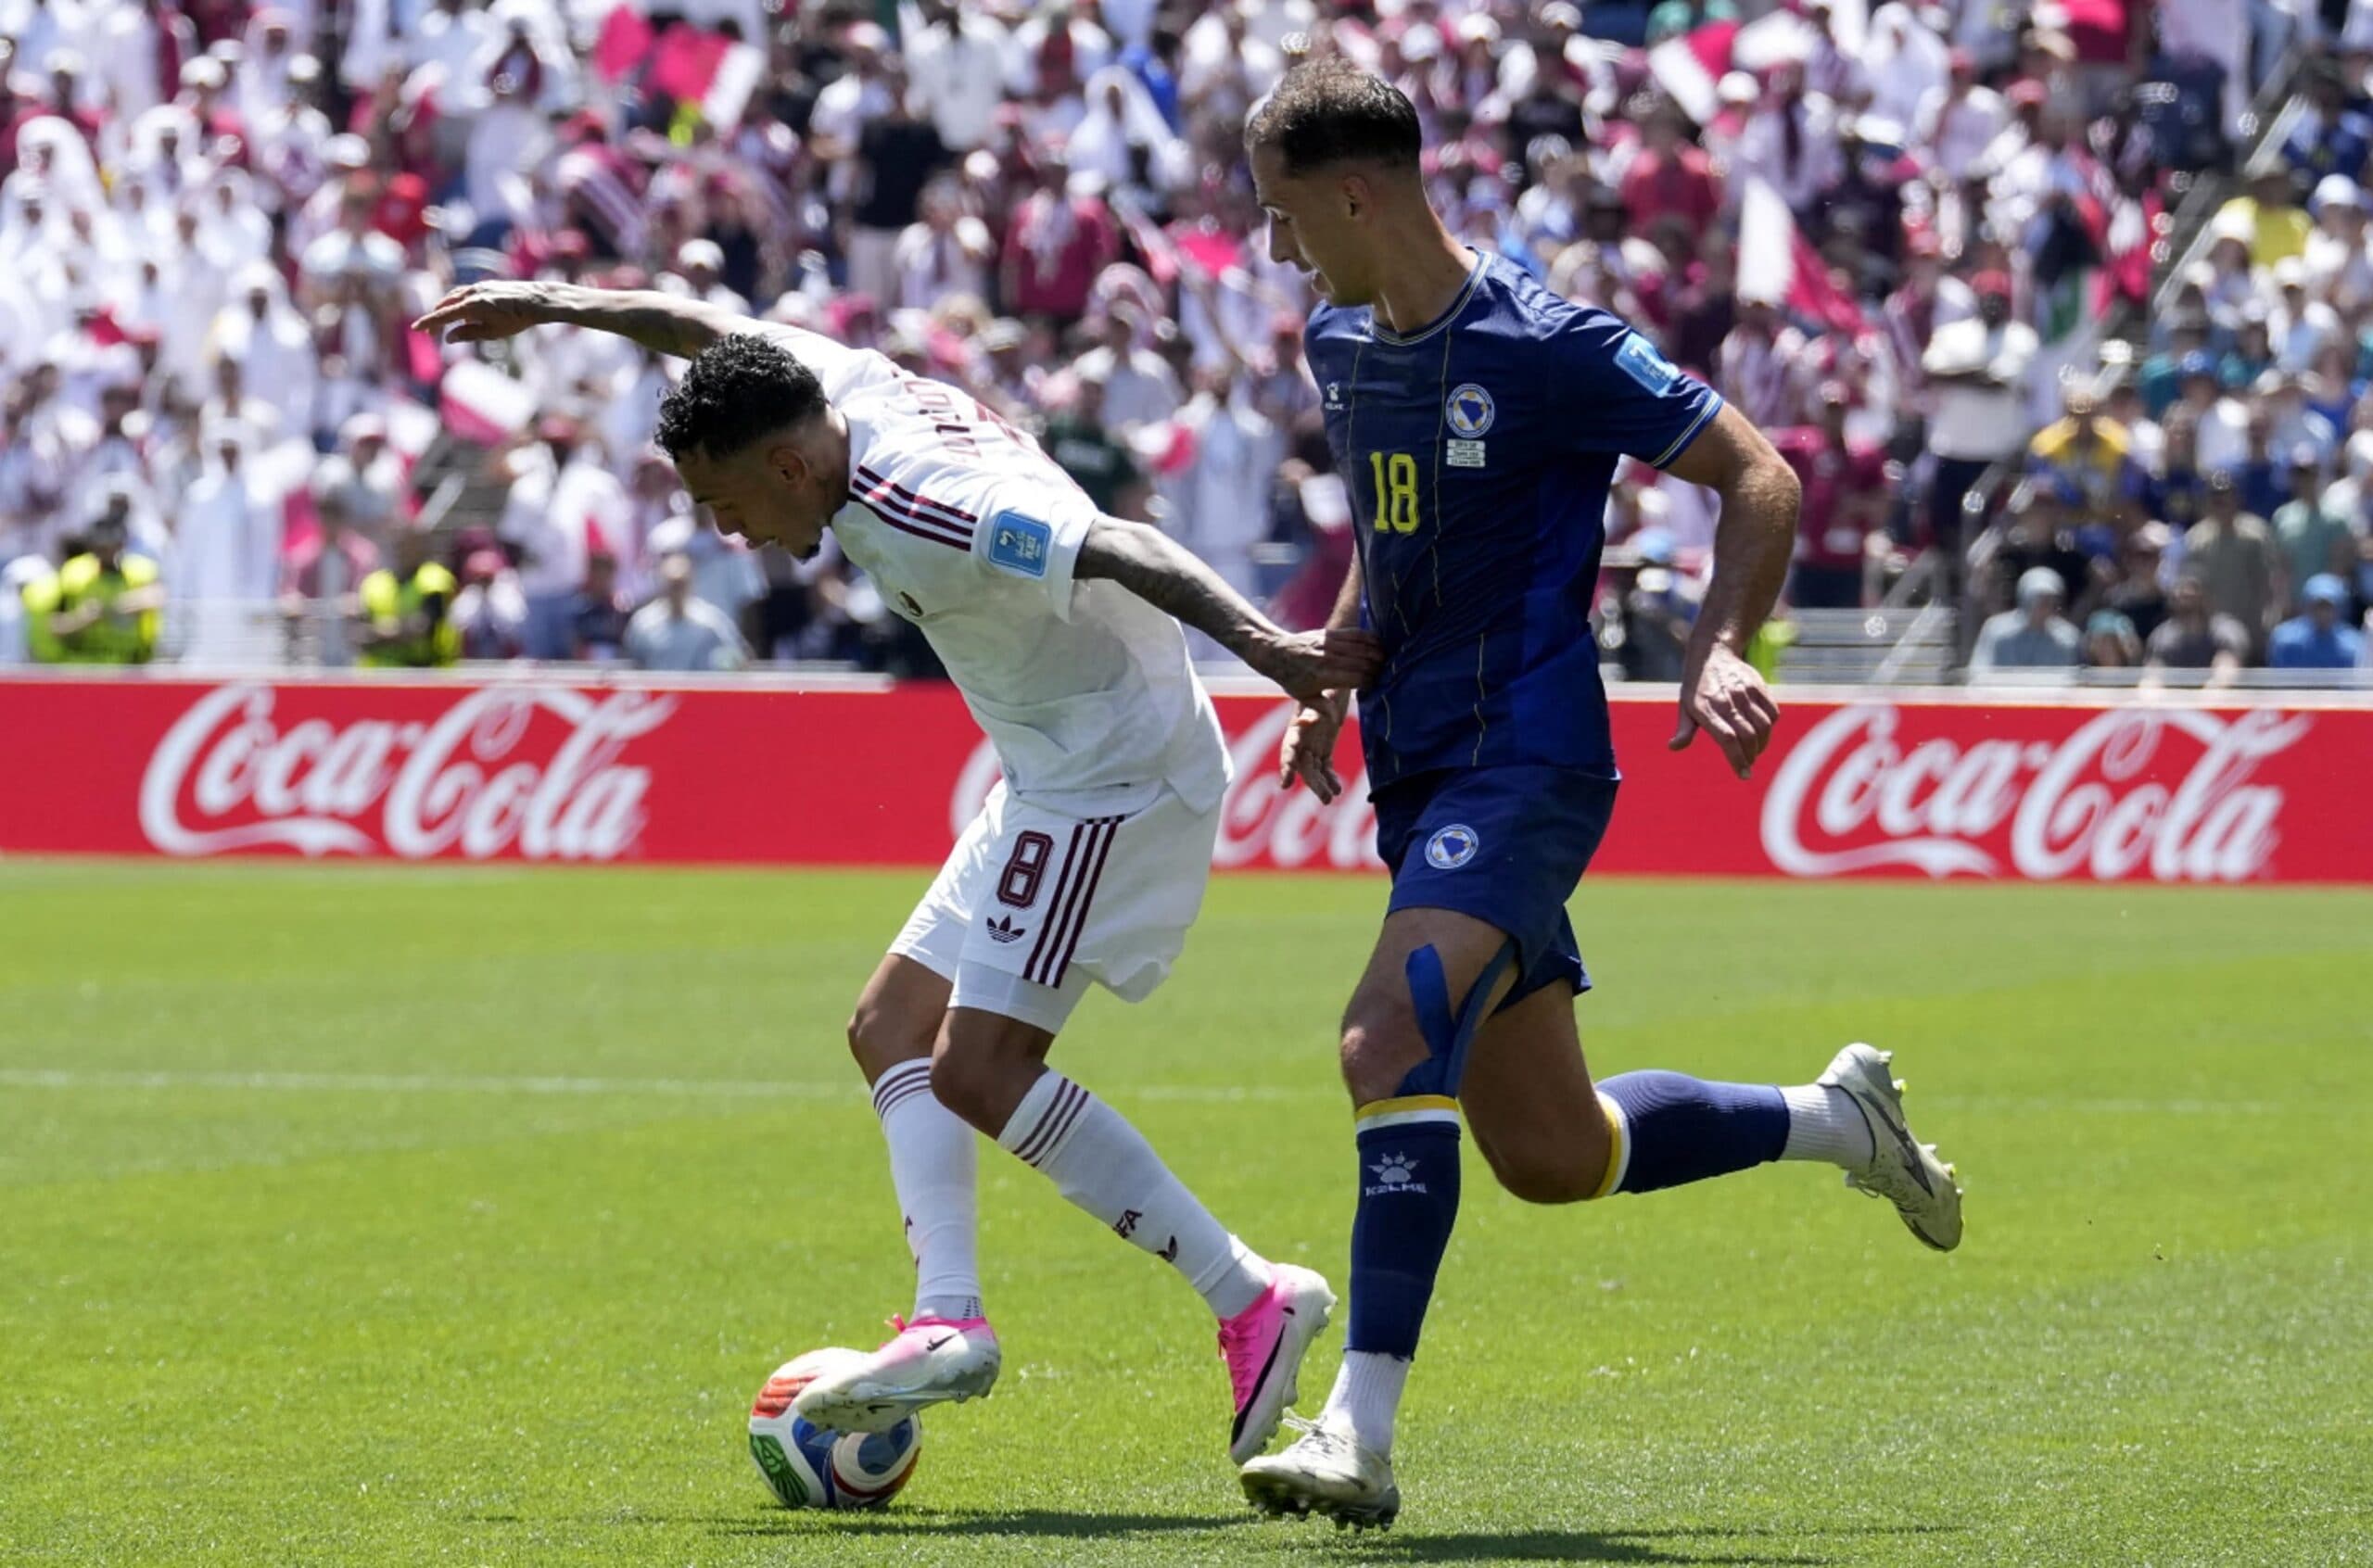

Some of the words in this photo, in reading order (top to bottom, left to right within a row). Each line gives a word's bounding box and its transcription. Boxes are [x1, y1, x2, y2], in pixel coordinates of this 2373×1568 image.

[1370, 450, 1419, 535] 18
[138, 680, 681, 858] Coca-Cola
[1759, 698, 2316, 881] Coca-Cola
[996, 830, 1054, 910] 8
[1112, 1208, 1143, 1239] FA
[1365, 1183, 1428, 1196] KELME
